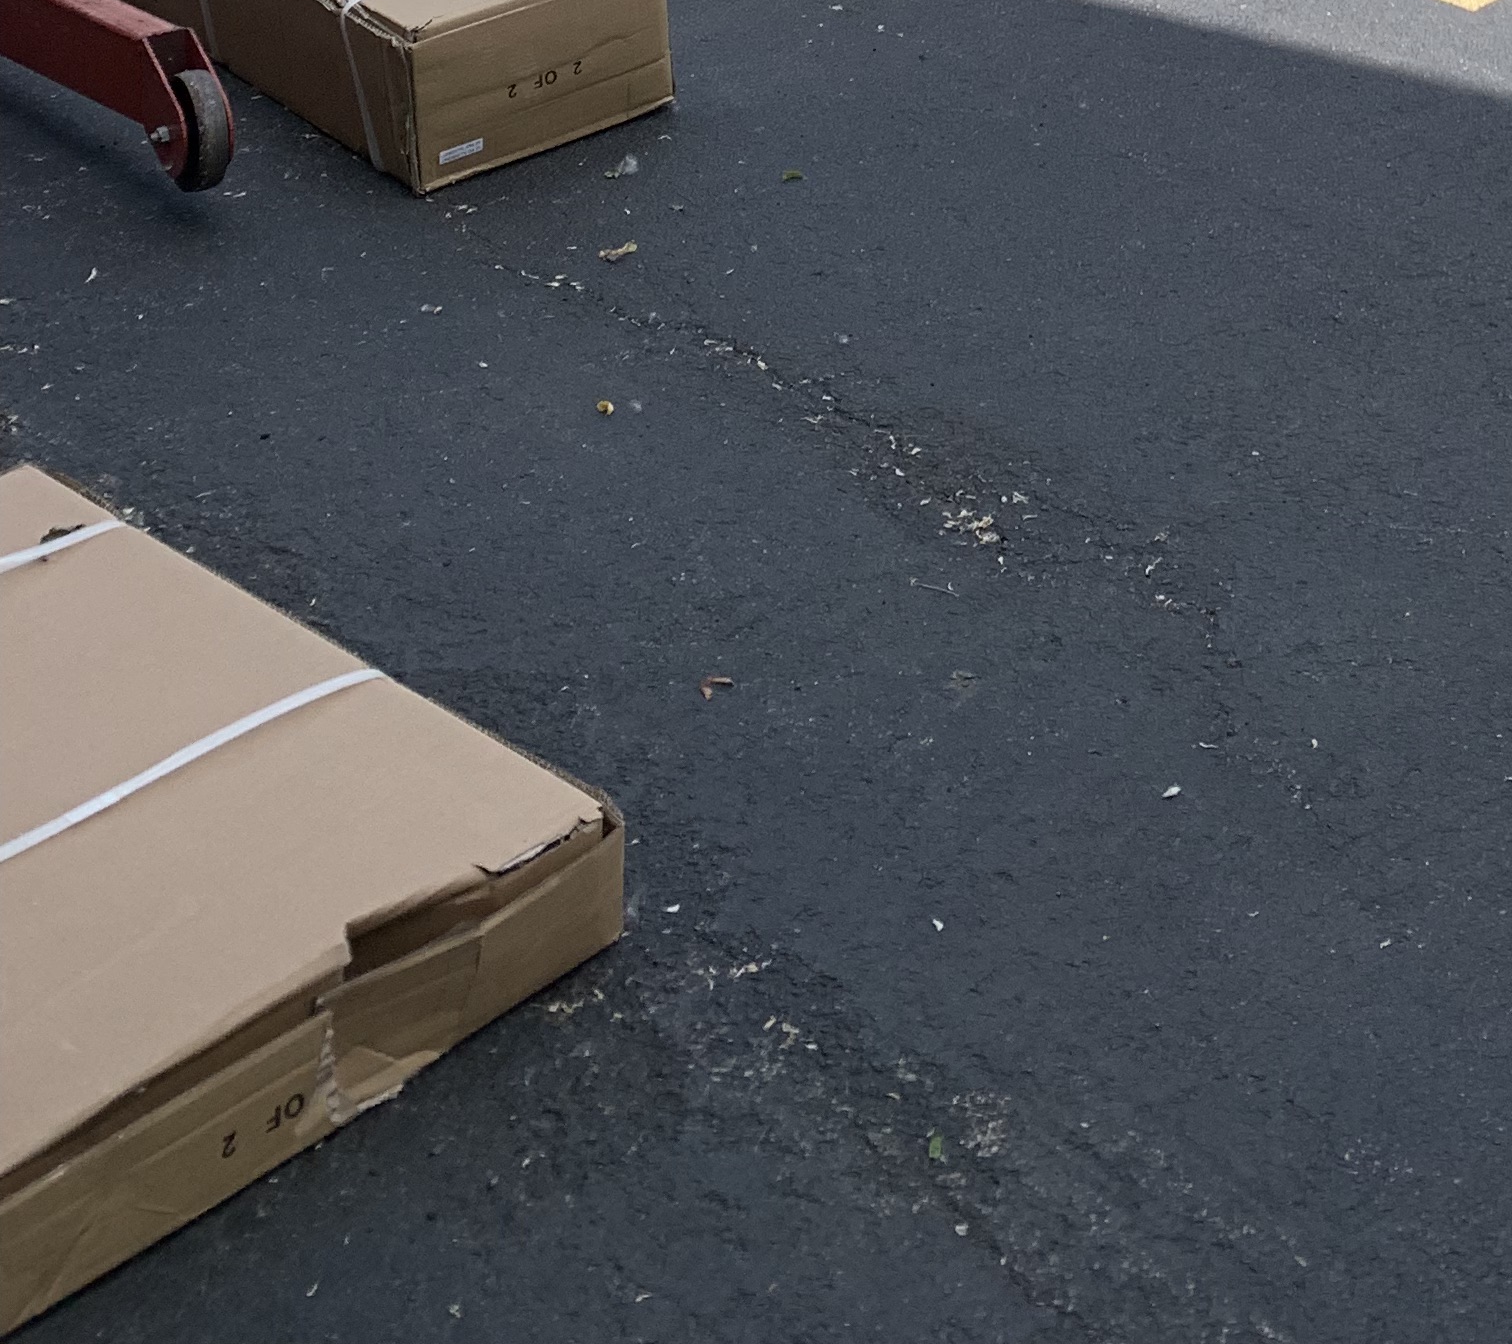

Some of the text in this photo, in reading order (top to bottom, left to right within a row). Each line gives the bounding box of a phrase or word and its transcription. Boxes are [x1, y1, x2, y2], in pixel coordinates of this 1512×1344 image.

[507, 60, 583, 99] 2 OF 2
[222, 1093, 304, 1159] OF 2
